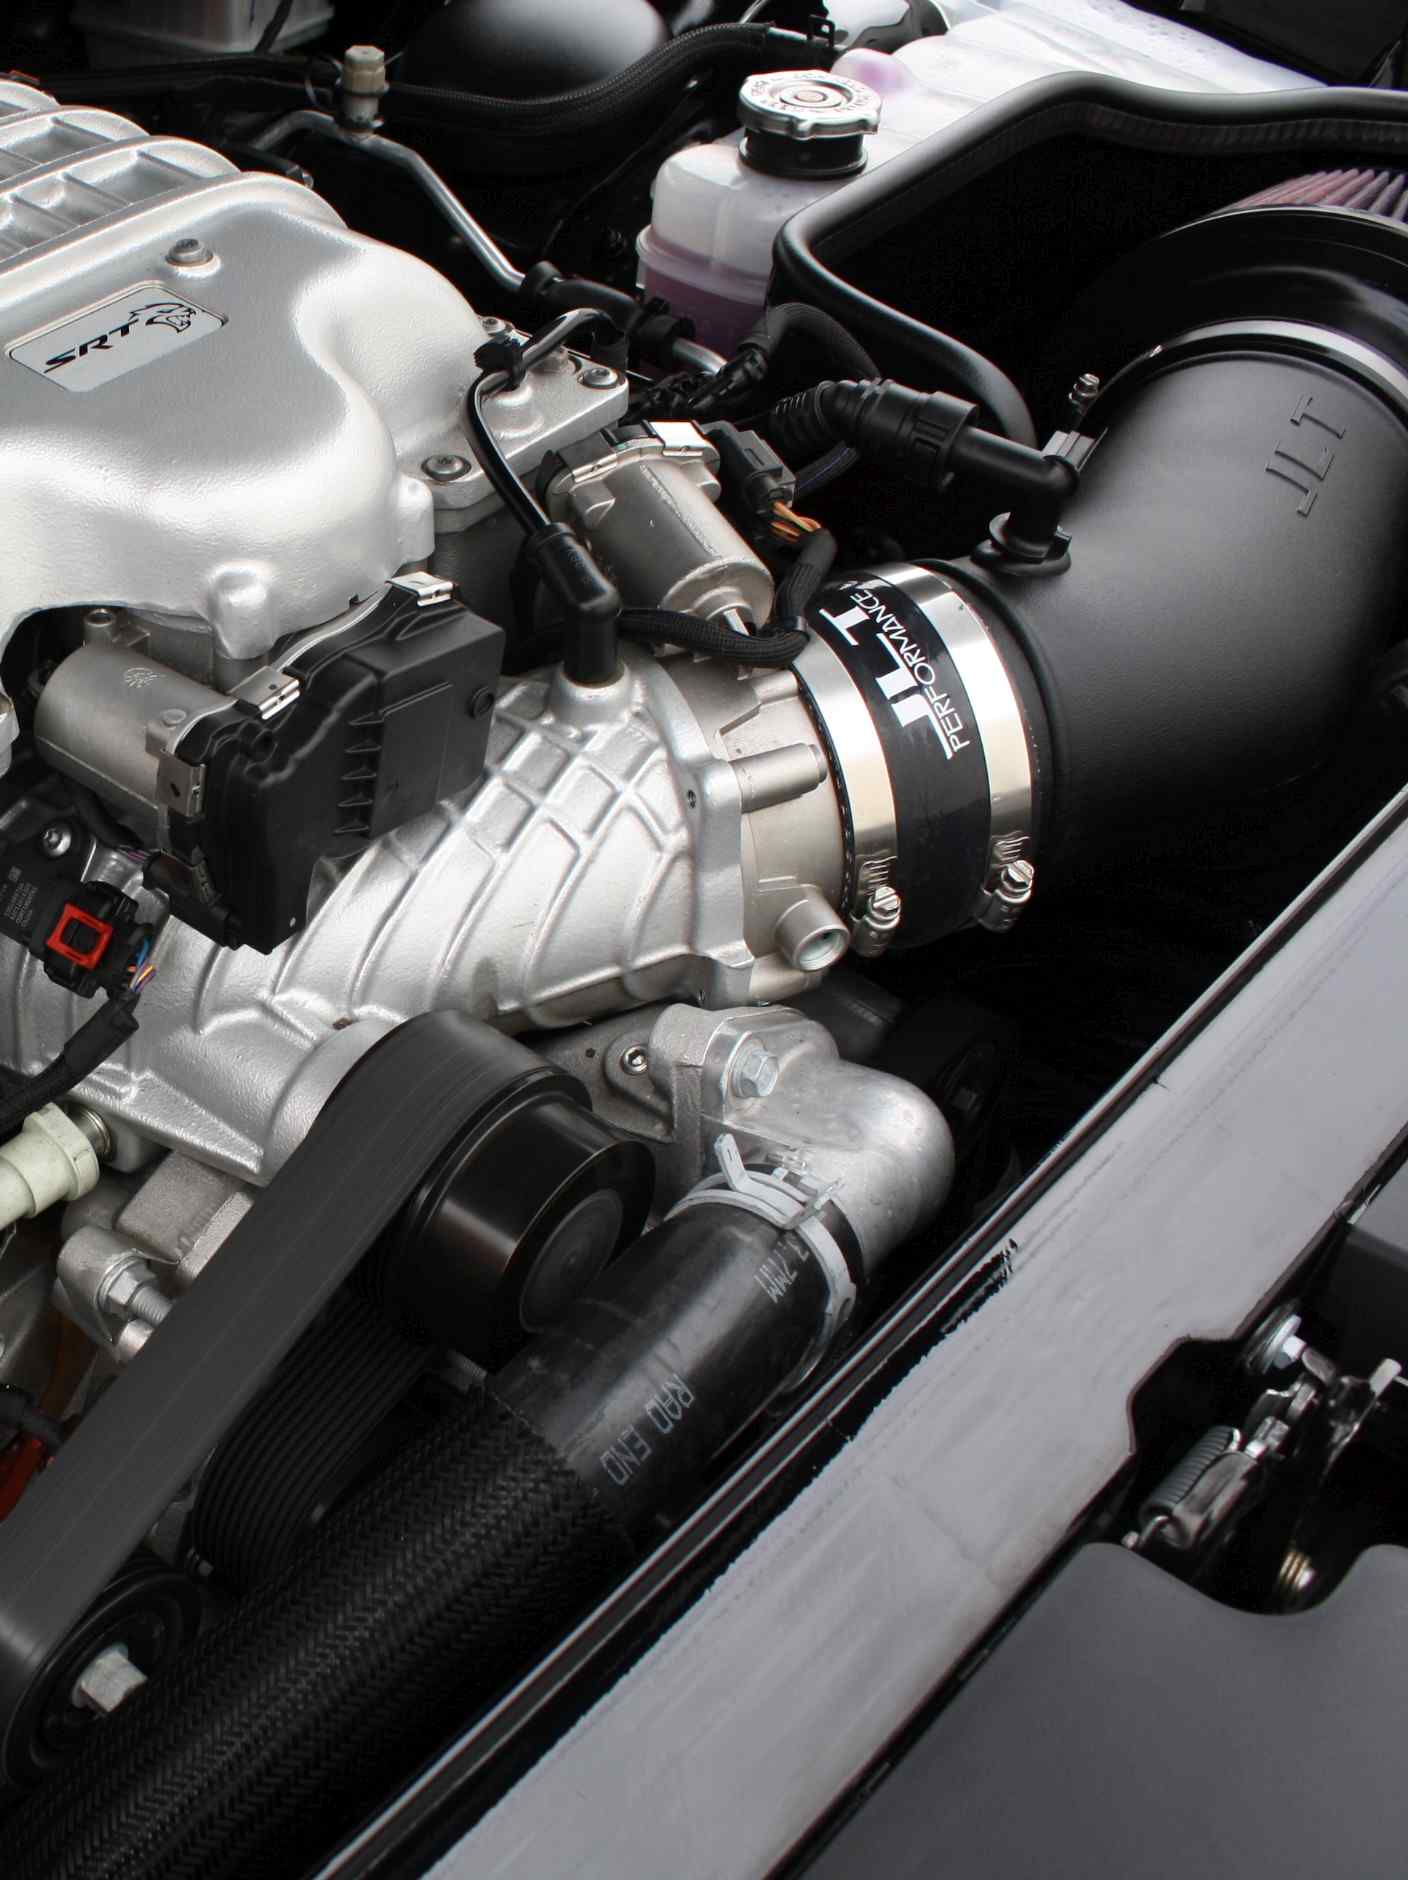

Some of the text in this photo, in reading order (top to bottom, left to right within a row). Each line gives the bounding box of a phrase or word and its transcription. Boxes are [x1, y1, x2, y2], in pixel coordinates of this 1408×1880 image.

[43, 318, 139, 374] SRT
[819, 606, 953, 760] JLT
[849, 587, 971, 754] PERFORMANCE
[599, 1373, 694, 1486] RAD END
